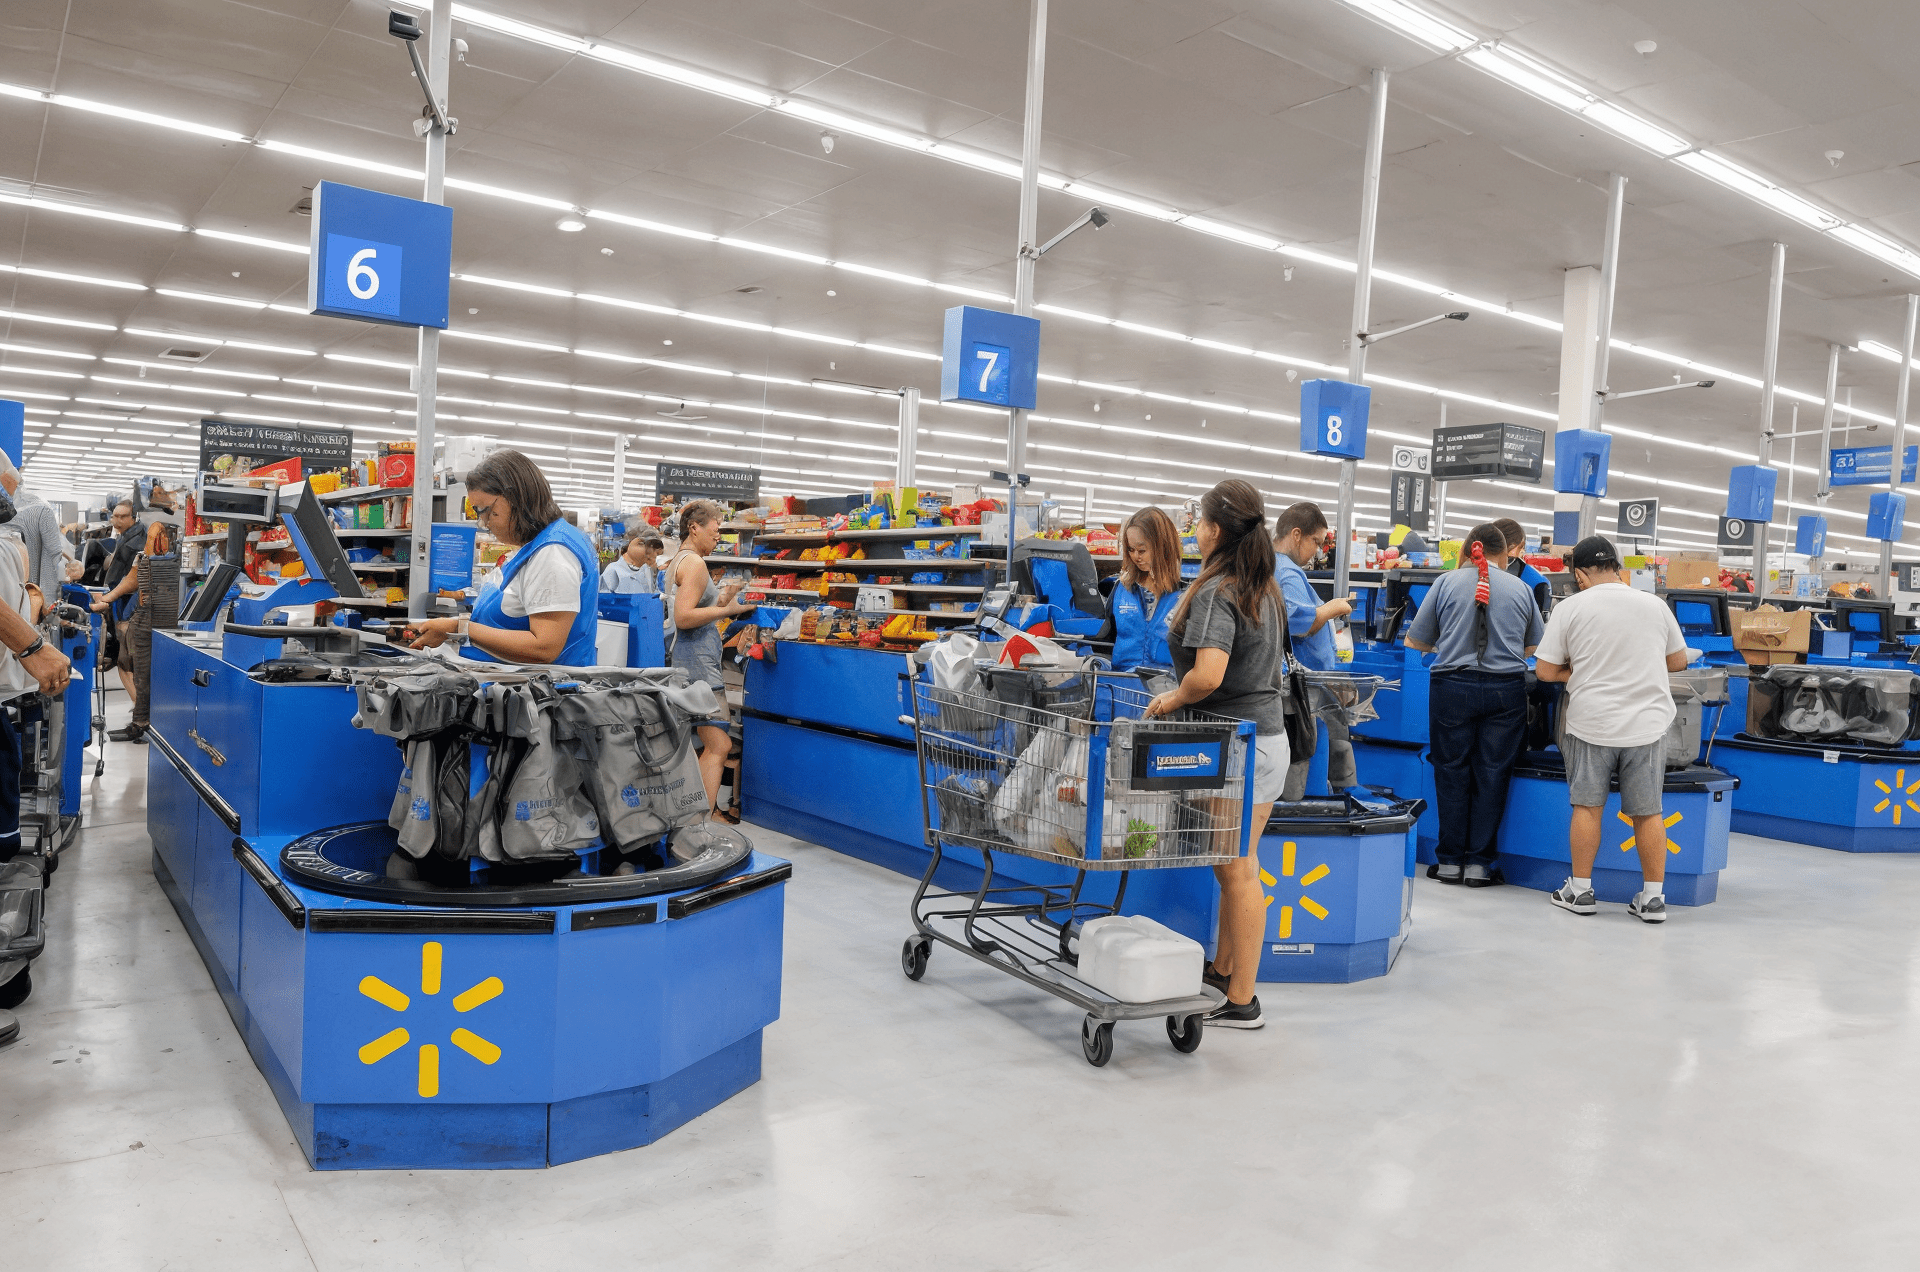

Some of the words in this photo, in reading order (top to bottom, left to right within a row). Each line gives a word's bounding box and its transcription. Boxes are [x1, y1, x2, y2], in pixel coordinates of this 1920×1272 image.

[346, 248, 380, 300] 6
[976, 350, 999, 393] 7
[1327, 415, 1342, 446] 8
